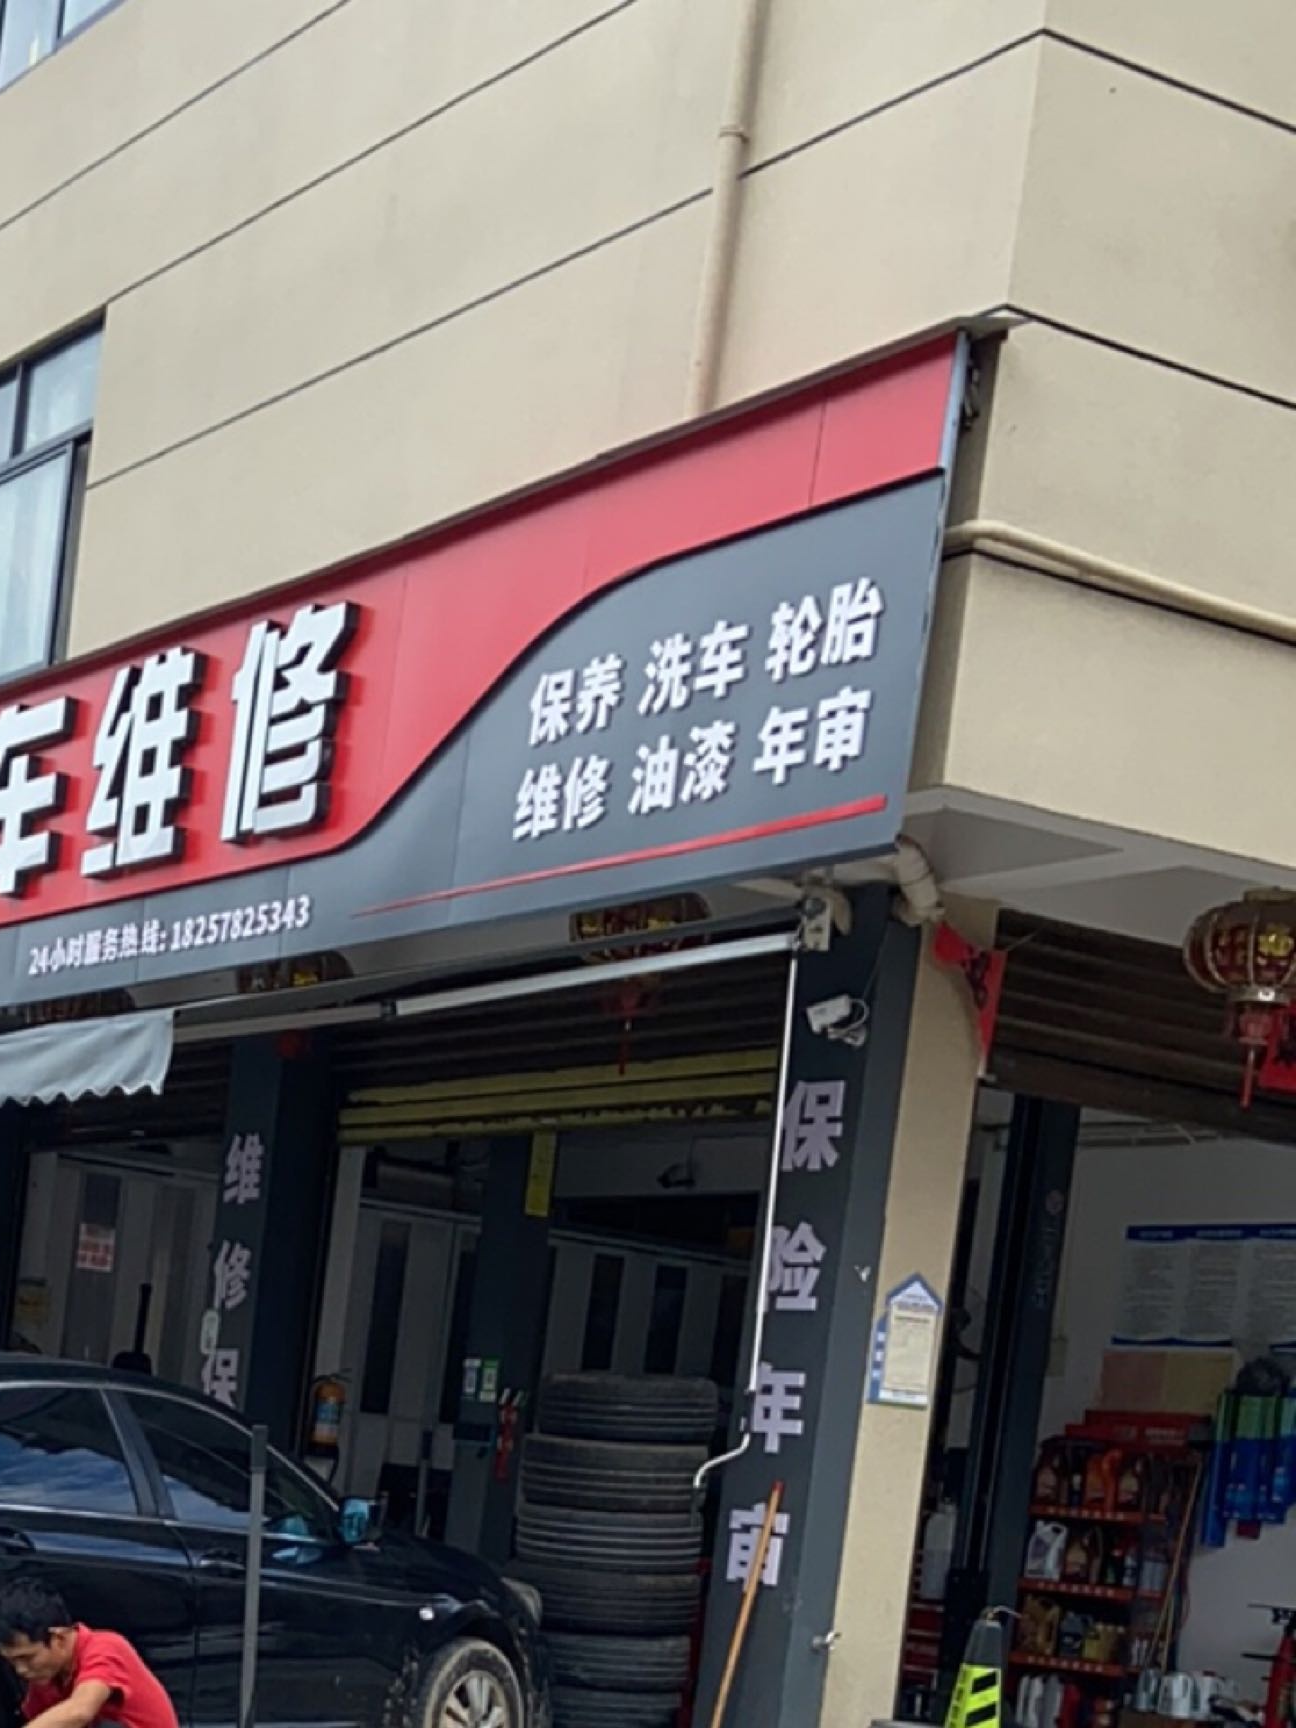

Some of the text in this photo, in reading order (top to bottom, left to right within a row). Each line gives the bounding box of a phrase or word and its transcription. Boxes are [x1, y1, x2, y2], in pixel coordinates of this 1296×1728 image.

[528, 576, 885, 747] 保养 洗车 轮胎
[512, 686, 873, 842] 维修 油漆 年审
[725, 1079, 847, 1588] 保险年审
